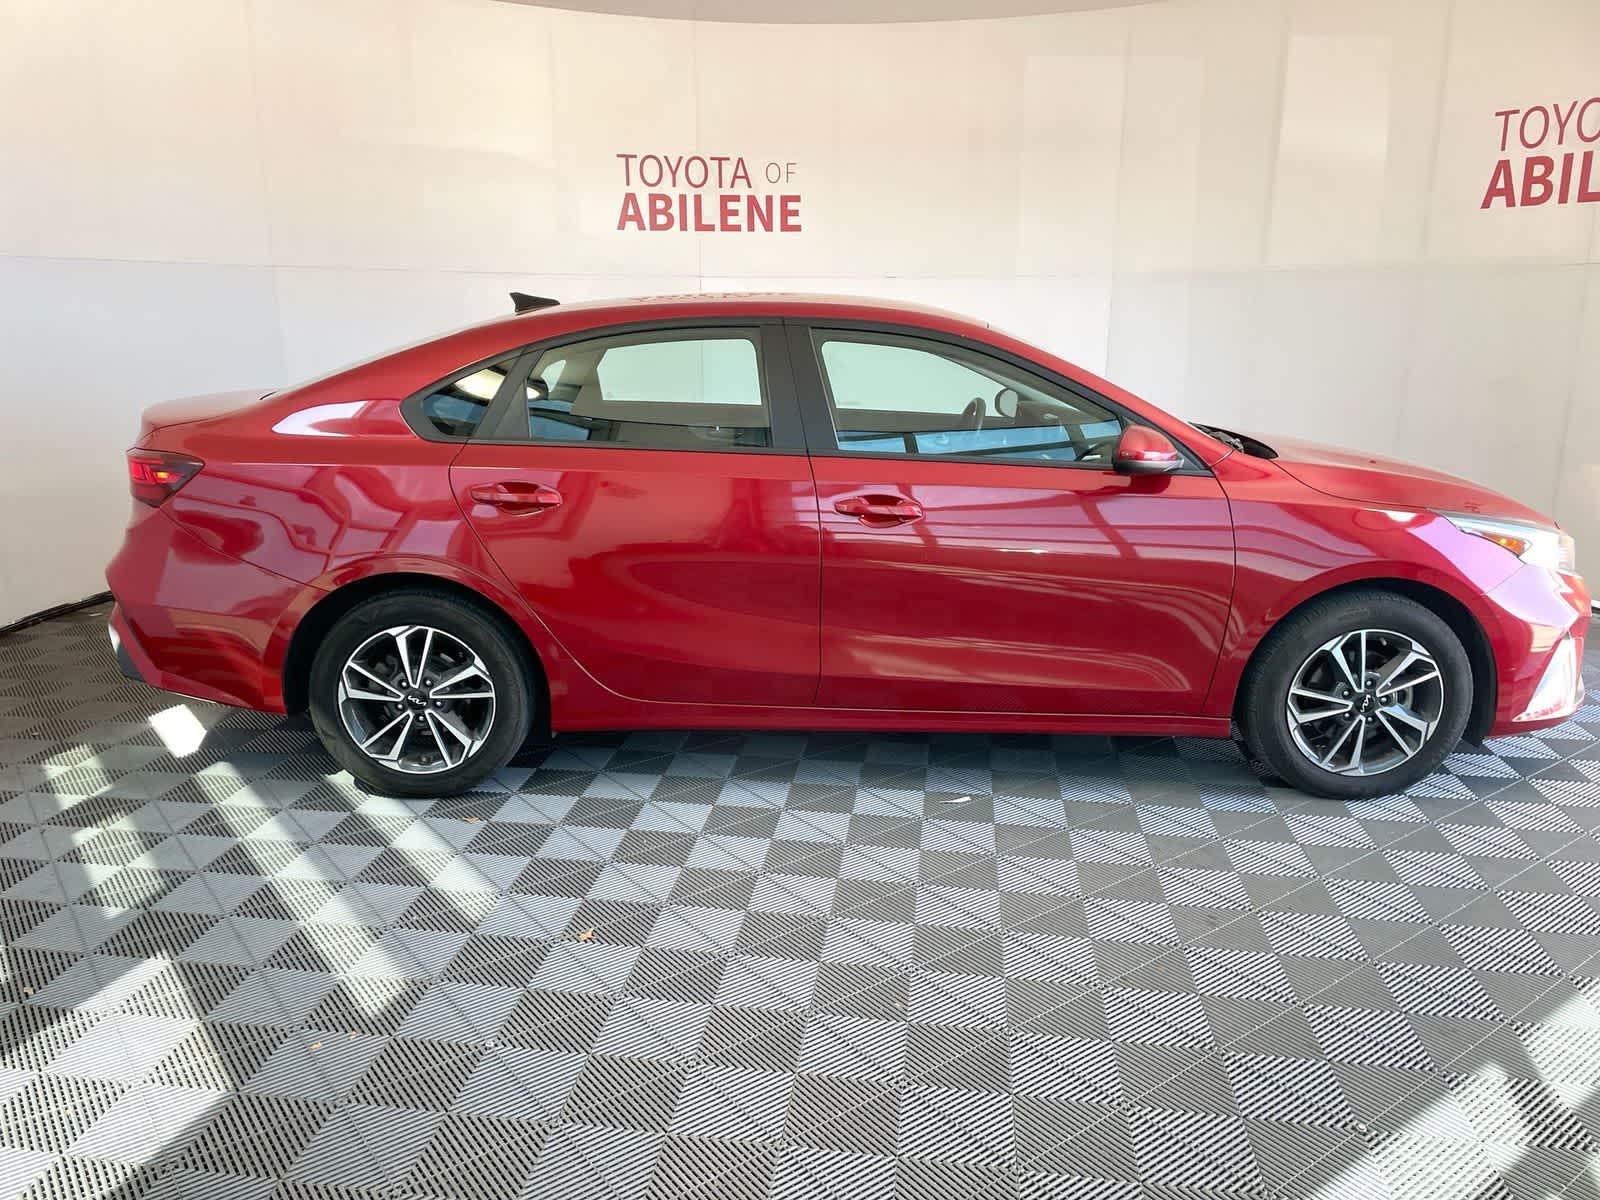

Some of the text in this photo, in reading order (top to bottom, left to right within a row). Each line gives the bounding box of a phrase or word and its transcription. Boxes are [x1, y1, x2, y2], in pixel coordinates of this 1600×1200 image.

[1495, 97, 1600, 151] TOYO
[616, 153, 797, 188] TOYOTA OF
[1480, 151, 1600, 209] ABIL
[616, 192, 802, 232] ABILENE
